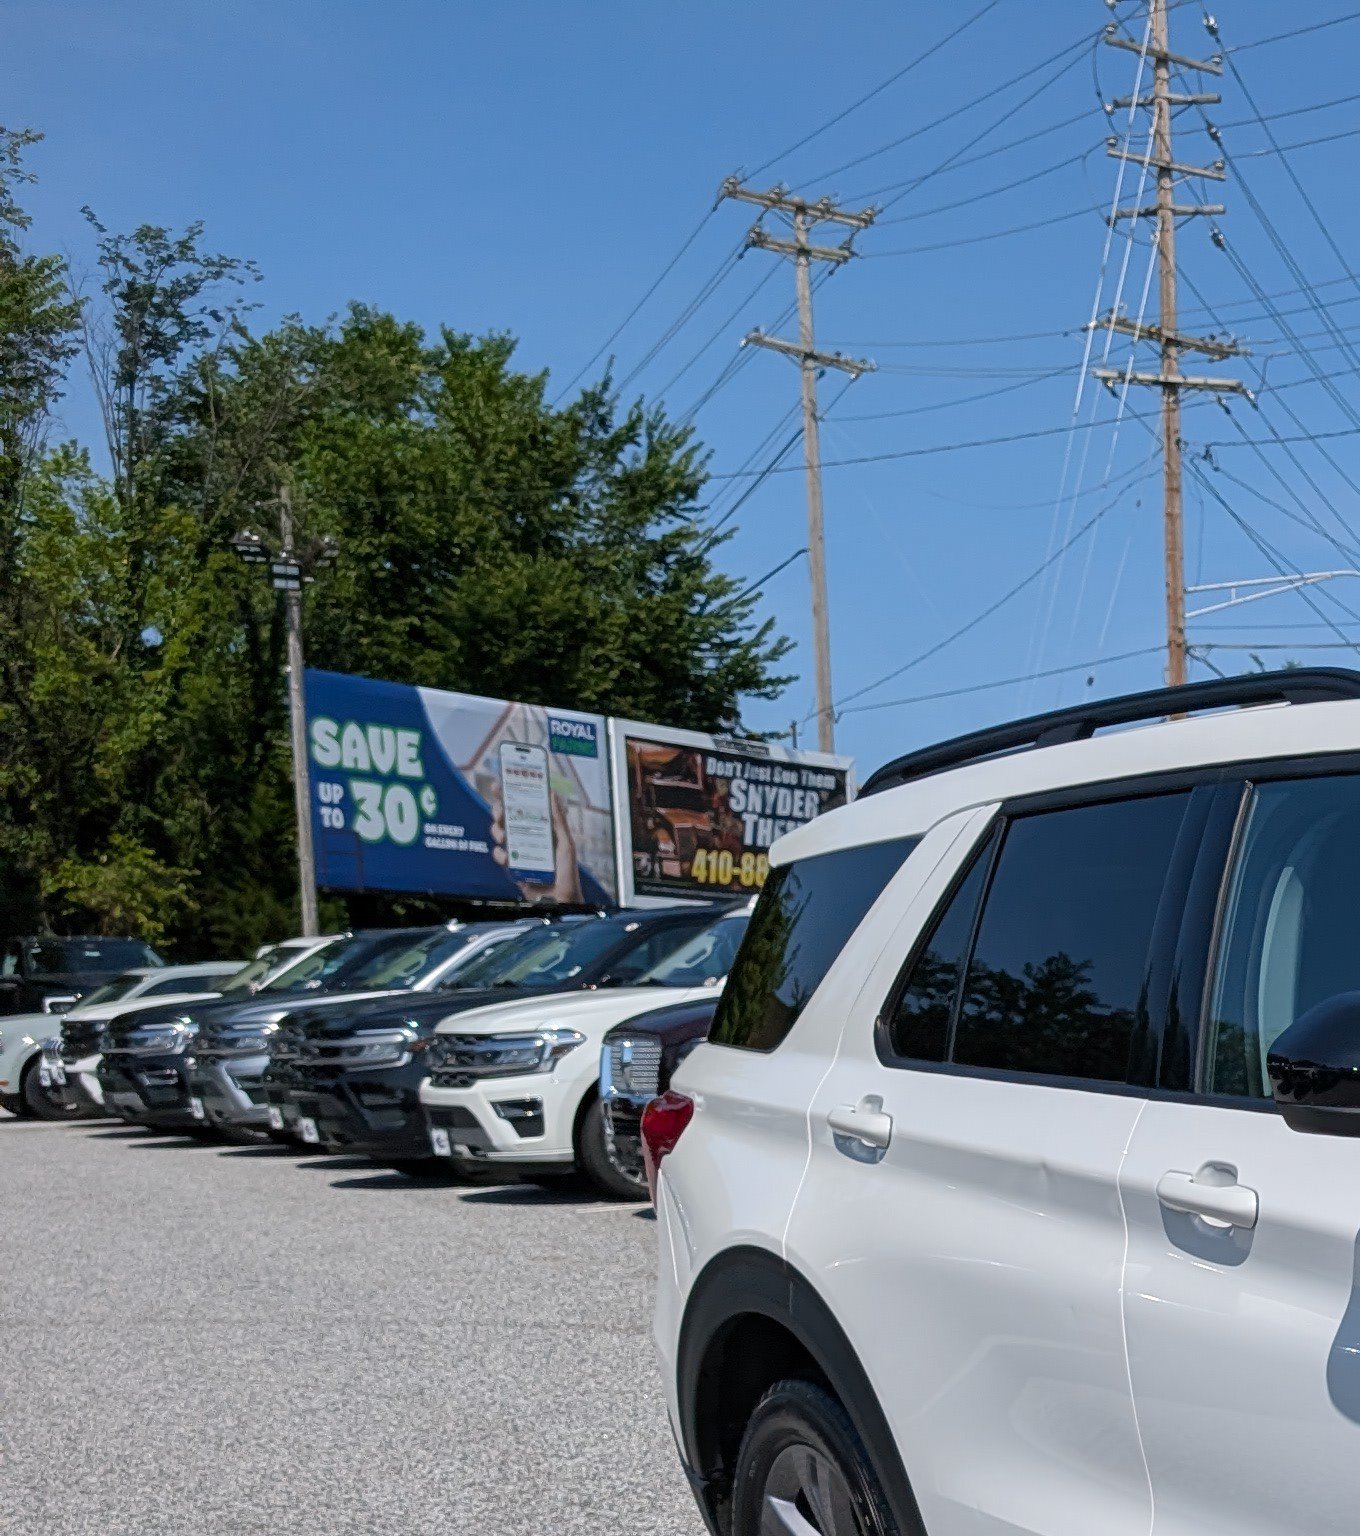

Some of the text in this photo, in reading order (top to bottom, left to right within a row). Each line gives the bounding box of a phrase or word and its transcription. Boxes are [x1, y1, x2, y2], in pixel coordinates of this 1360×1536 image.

[551, 720, 596, 740] ROYAL
[312, 718, 424, 777] SAVE
[319, 781, 344, 804] UP
[320, 806, 345, 829] TO
